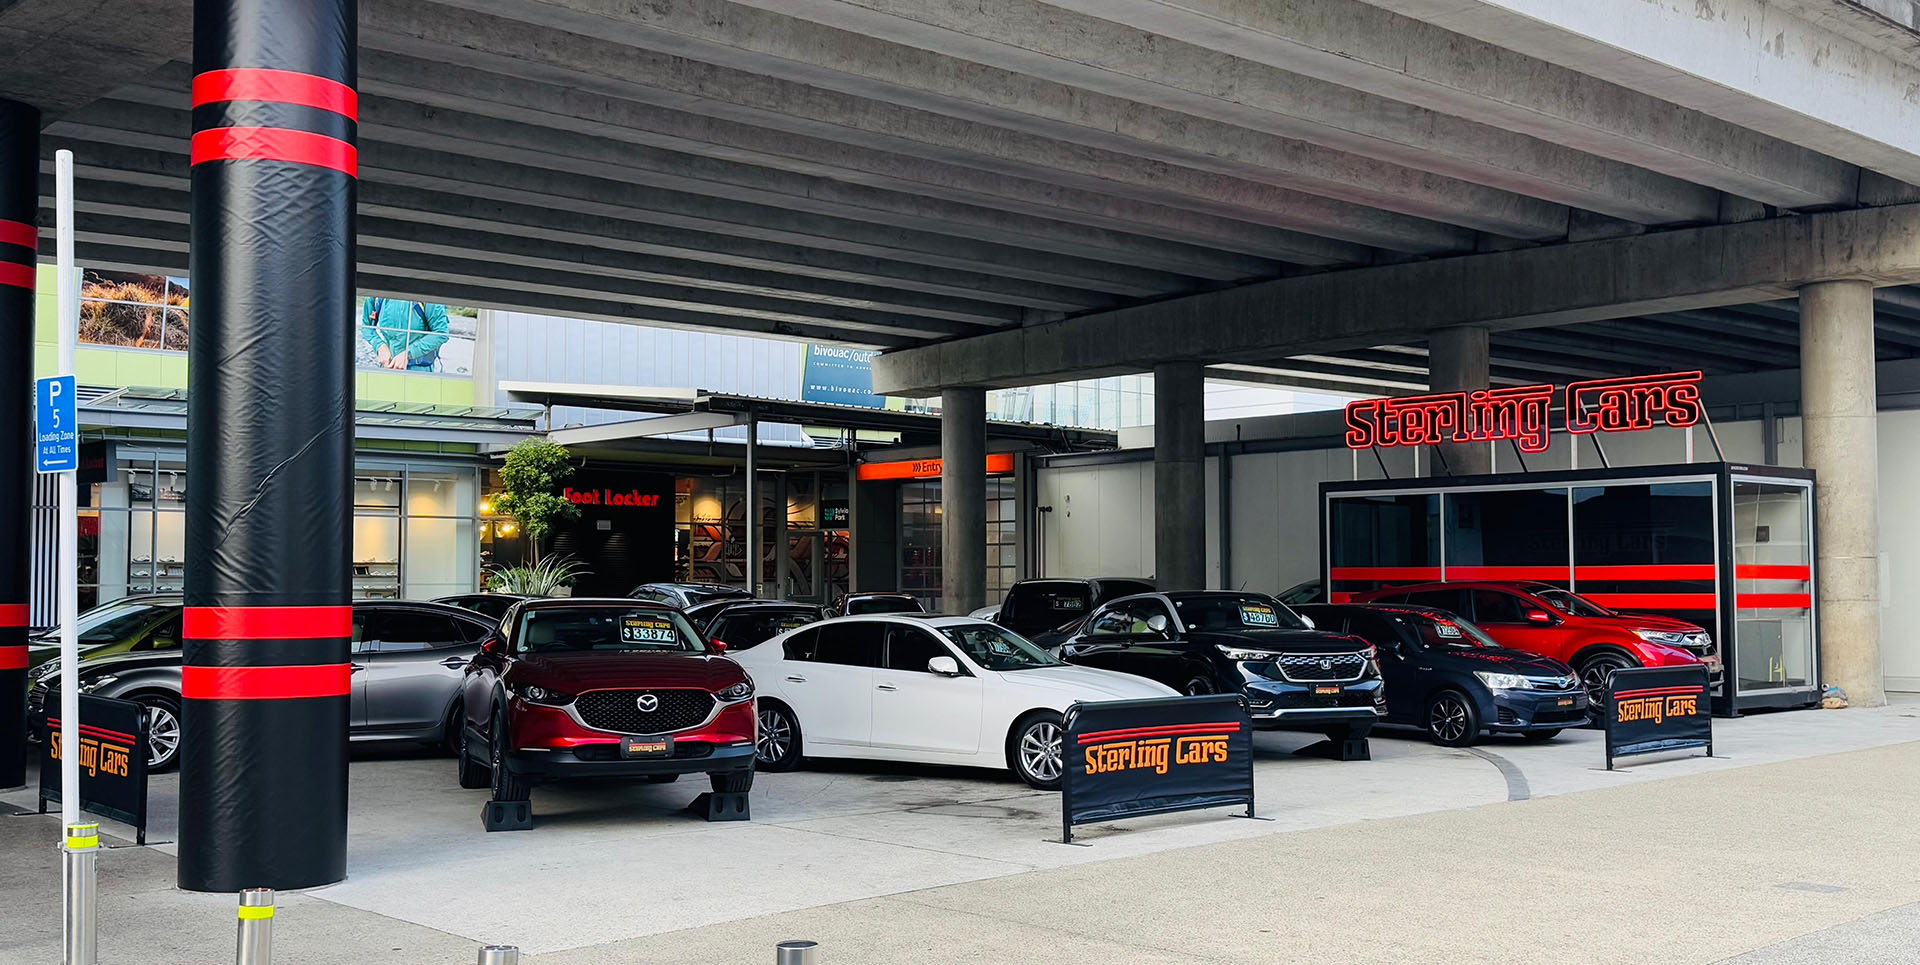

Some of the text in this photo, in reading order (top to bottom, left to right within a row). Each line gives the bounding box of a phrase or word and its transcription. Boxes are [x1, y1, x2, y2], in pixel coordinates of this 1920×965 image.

[50, 381, 62, 407] P
[53, 409, 60, 429] 5
[1345, 370, 1703, 452] Sterling Cars
[39, 430, 74, 442] Loading Zone
[57, 444, 71, 454] Times
[922, 461, 943, 474] Entry
[563, 487, 660, 507] Foot Locker
[1618, 695, 1697, 724] Sterling Cars
[100, 743, 130, 777] Cars
[1085, 735, 1230, 774] Sterling Cars
